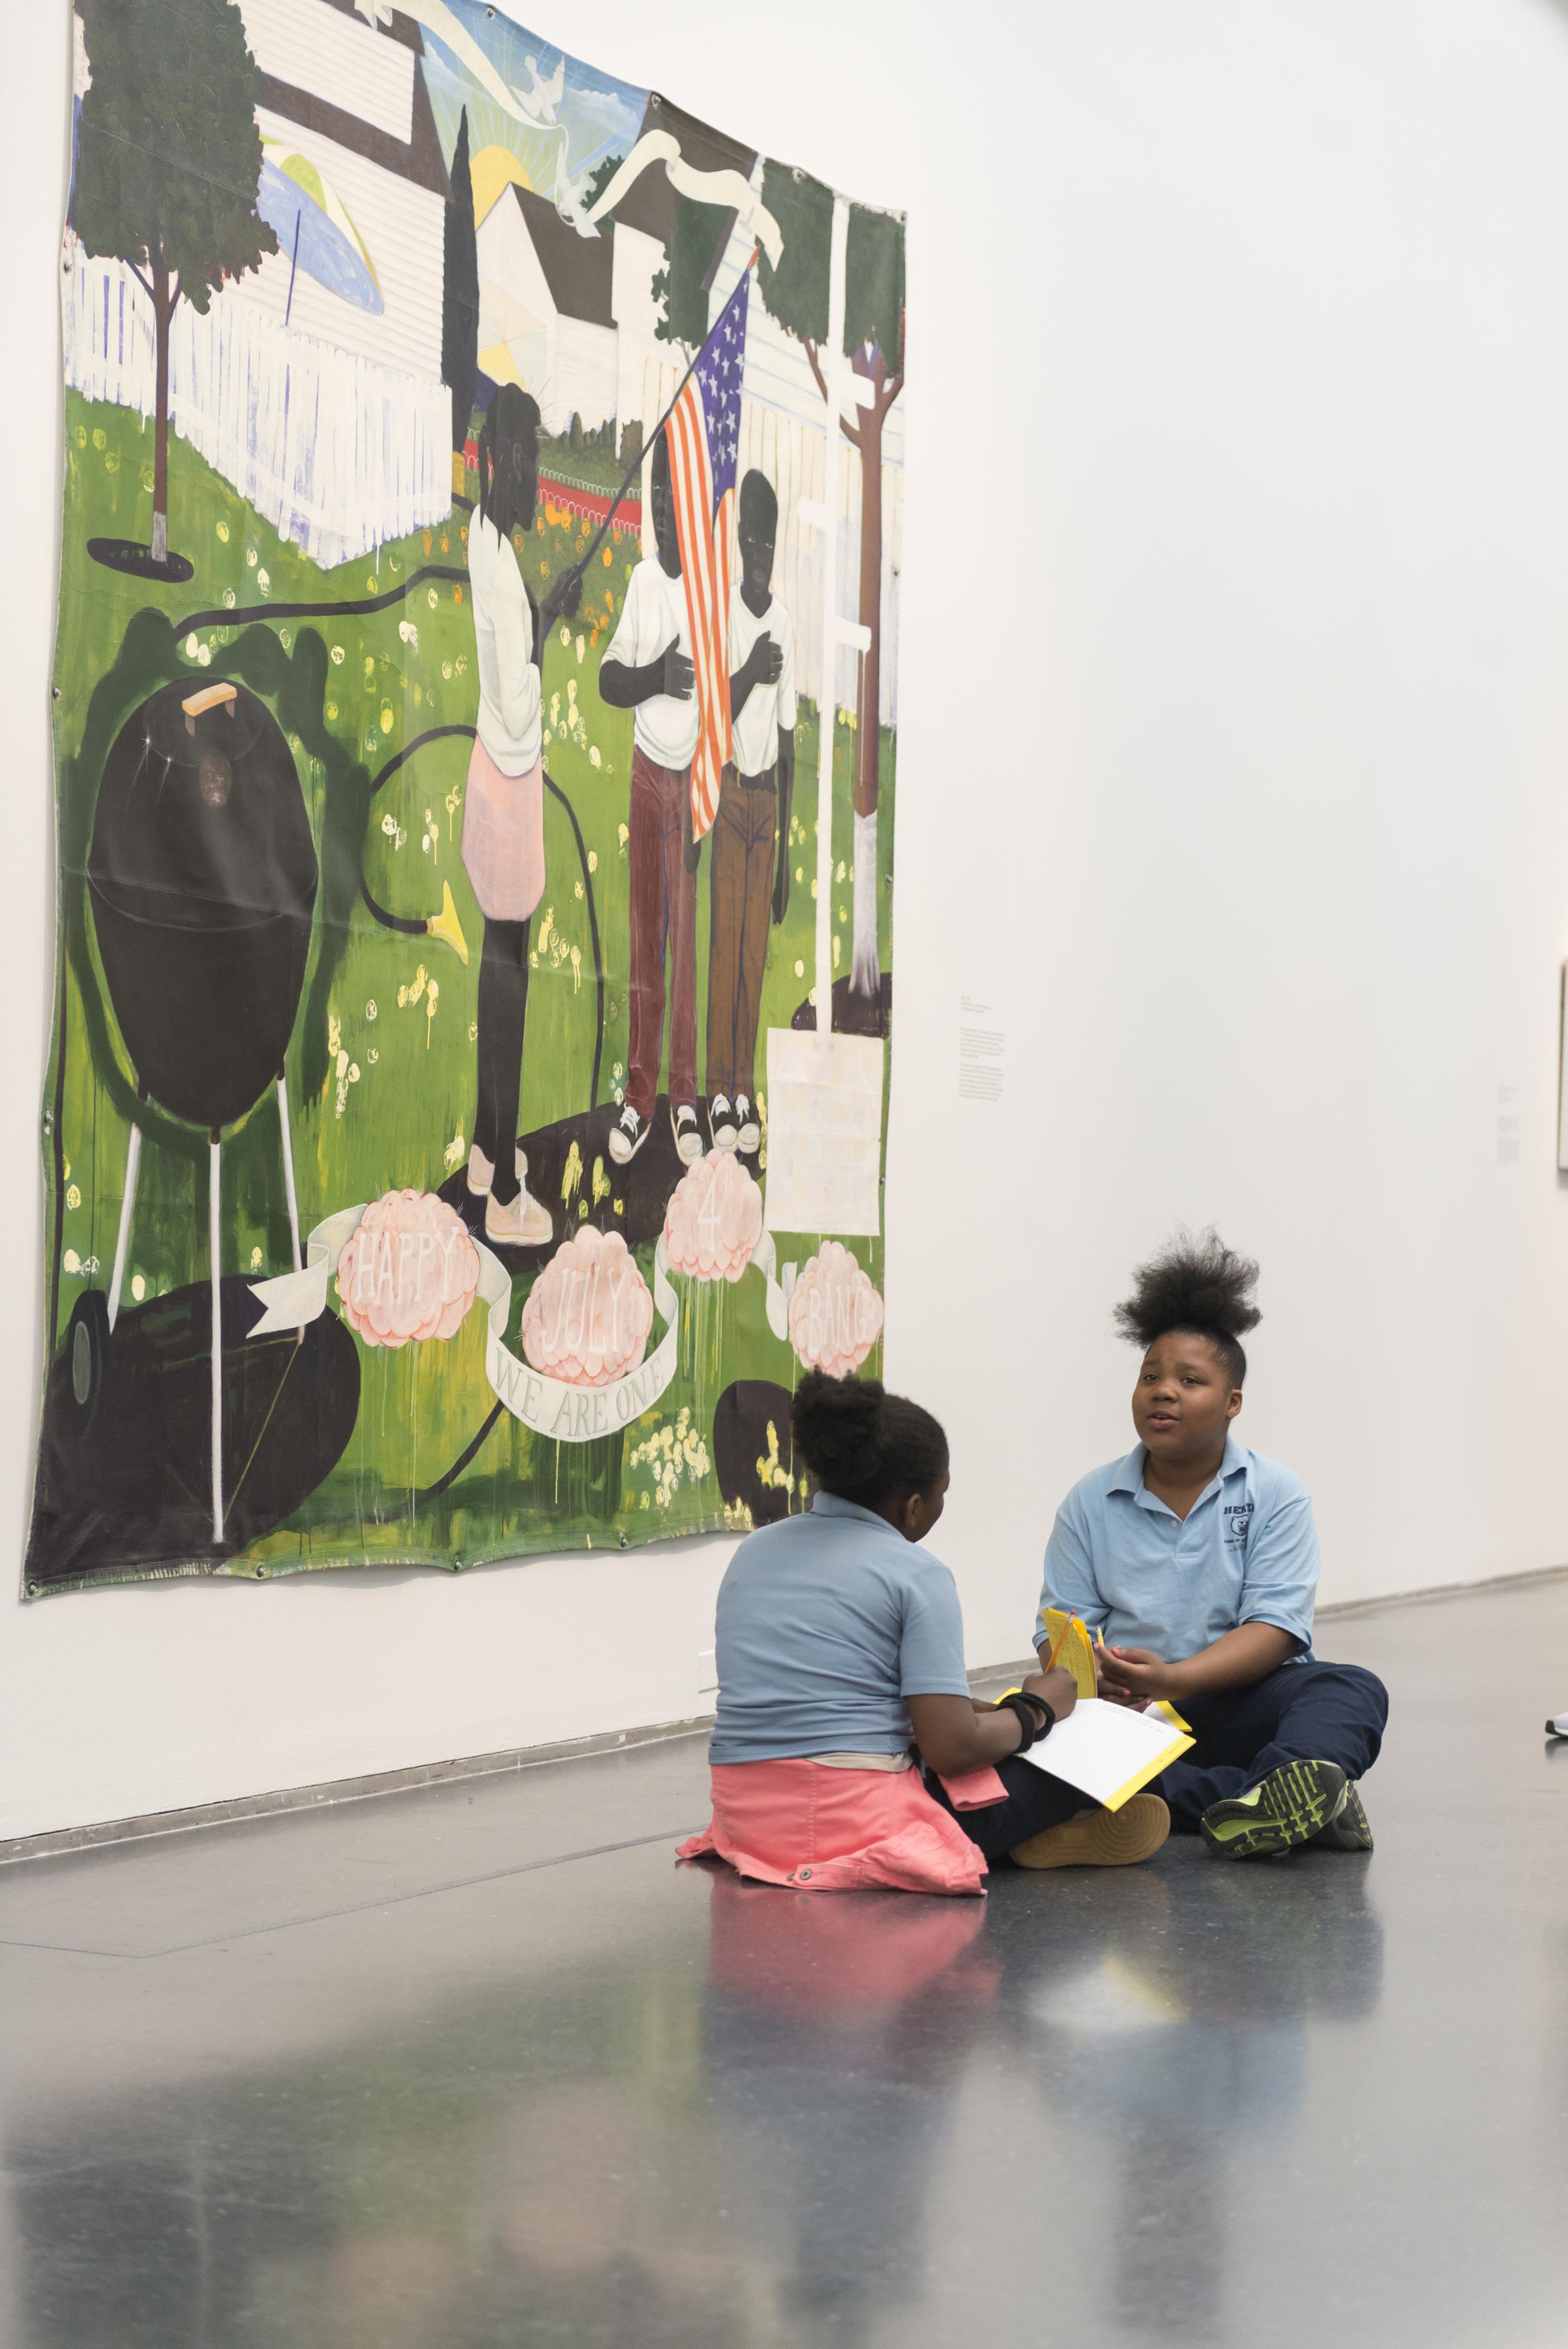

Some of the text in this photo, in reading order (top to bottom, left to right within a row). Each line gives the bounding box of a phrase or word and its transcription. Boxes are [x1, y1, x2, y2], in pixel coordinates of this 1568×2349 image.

[354, 1226, 459, 1305] HAPPY
[542, 1265, 628, 1354] JULY
[809, 1283, 871, 1352] BANG
[495, 1347, 664, 1437] WE ARE ONE
